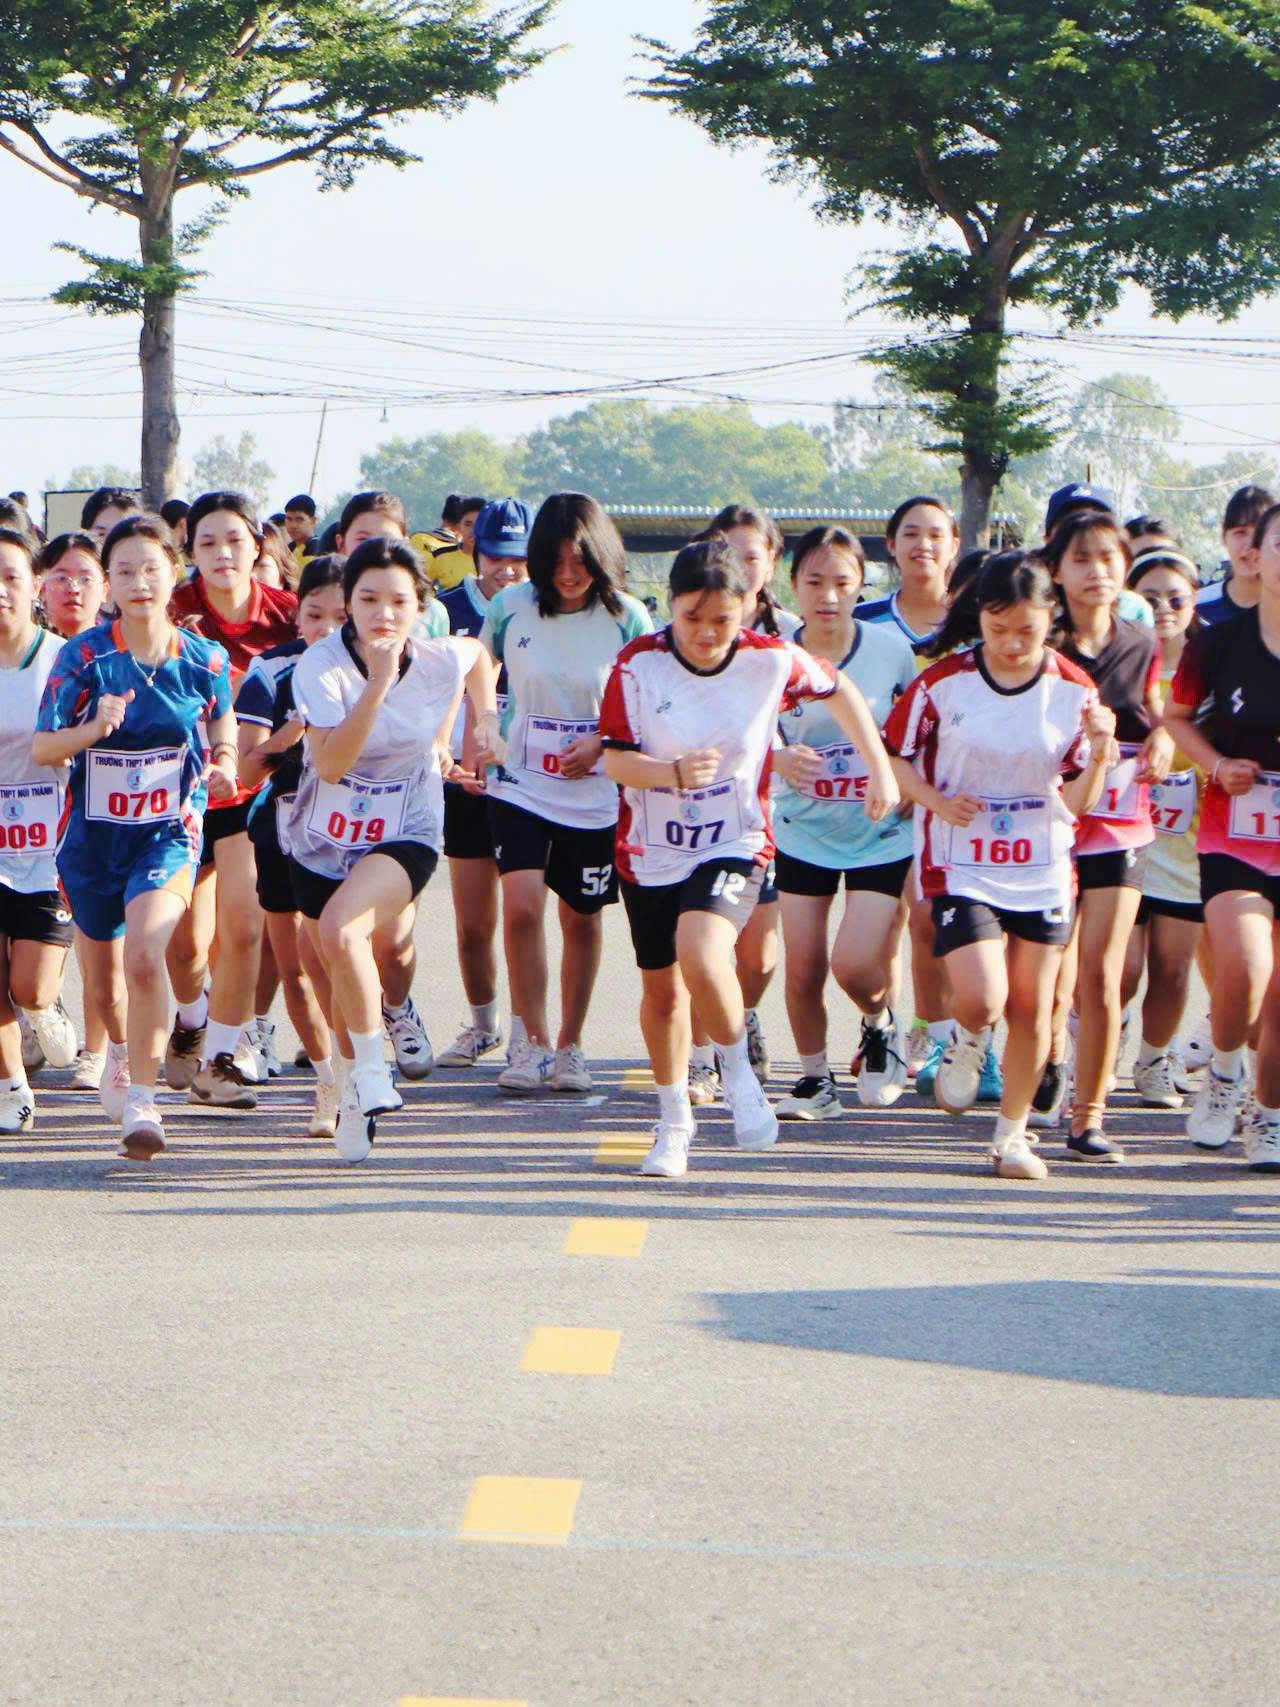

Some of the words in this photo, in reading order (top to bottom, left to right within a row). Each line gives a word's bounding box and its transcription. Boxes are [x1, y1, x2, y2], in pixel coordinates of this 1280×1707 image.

[815, 776, 869, 798] 075
[108, 788, 168, 817] 070
[327, 811, 385, 843] 019
[666, 820, 725, 848] 077
[969, 838, 1032, 864] 160
[581, 864, 613, 896] 52
[712, 870, 747, 904] 12
